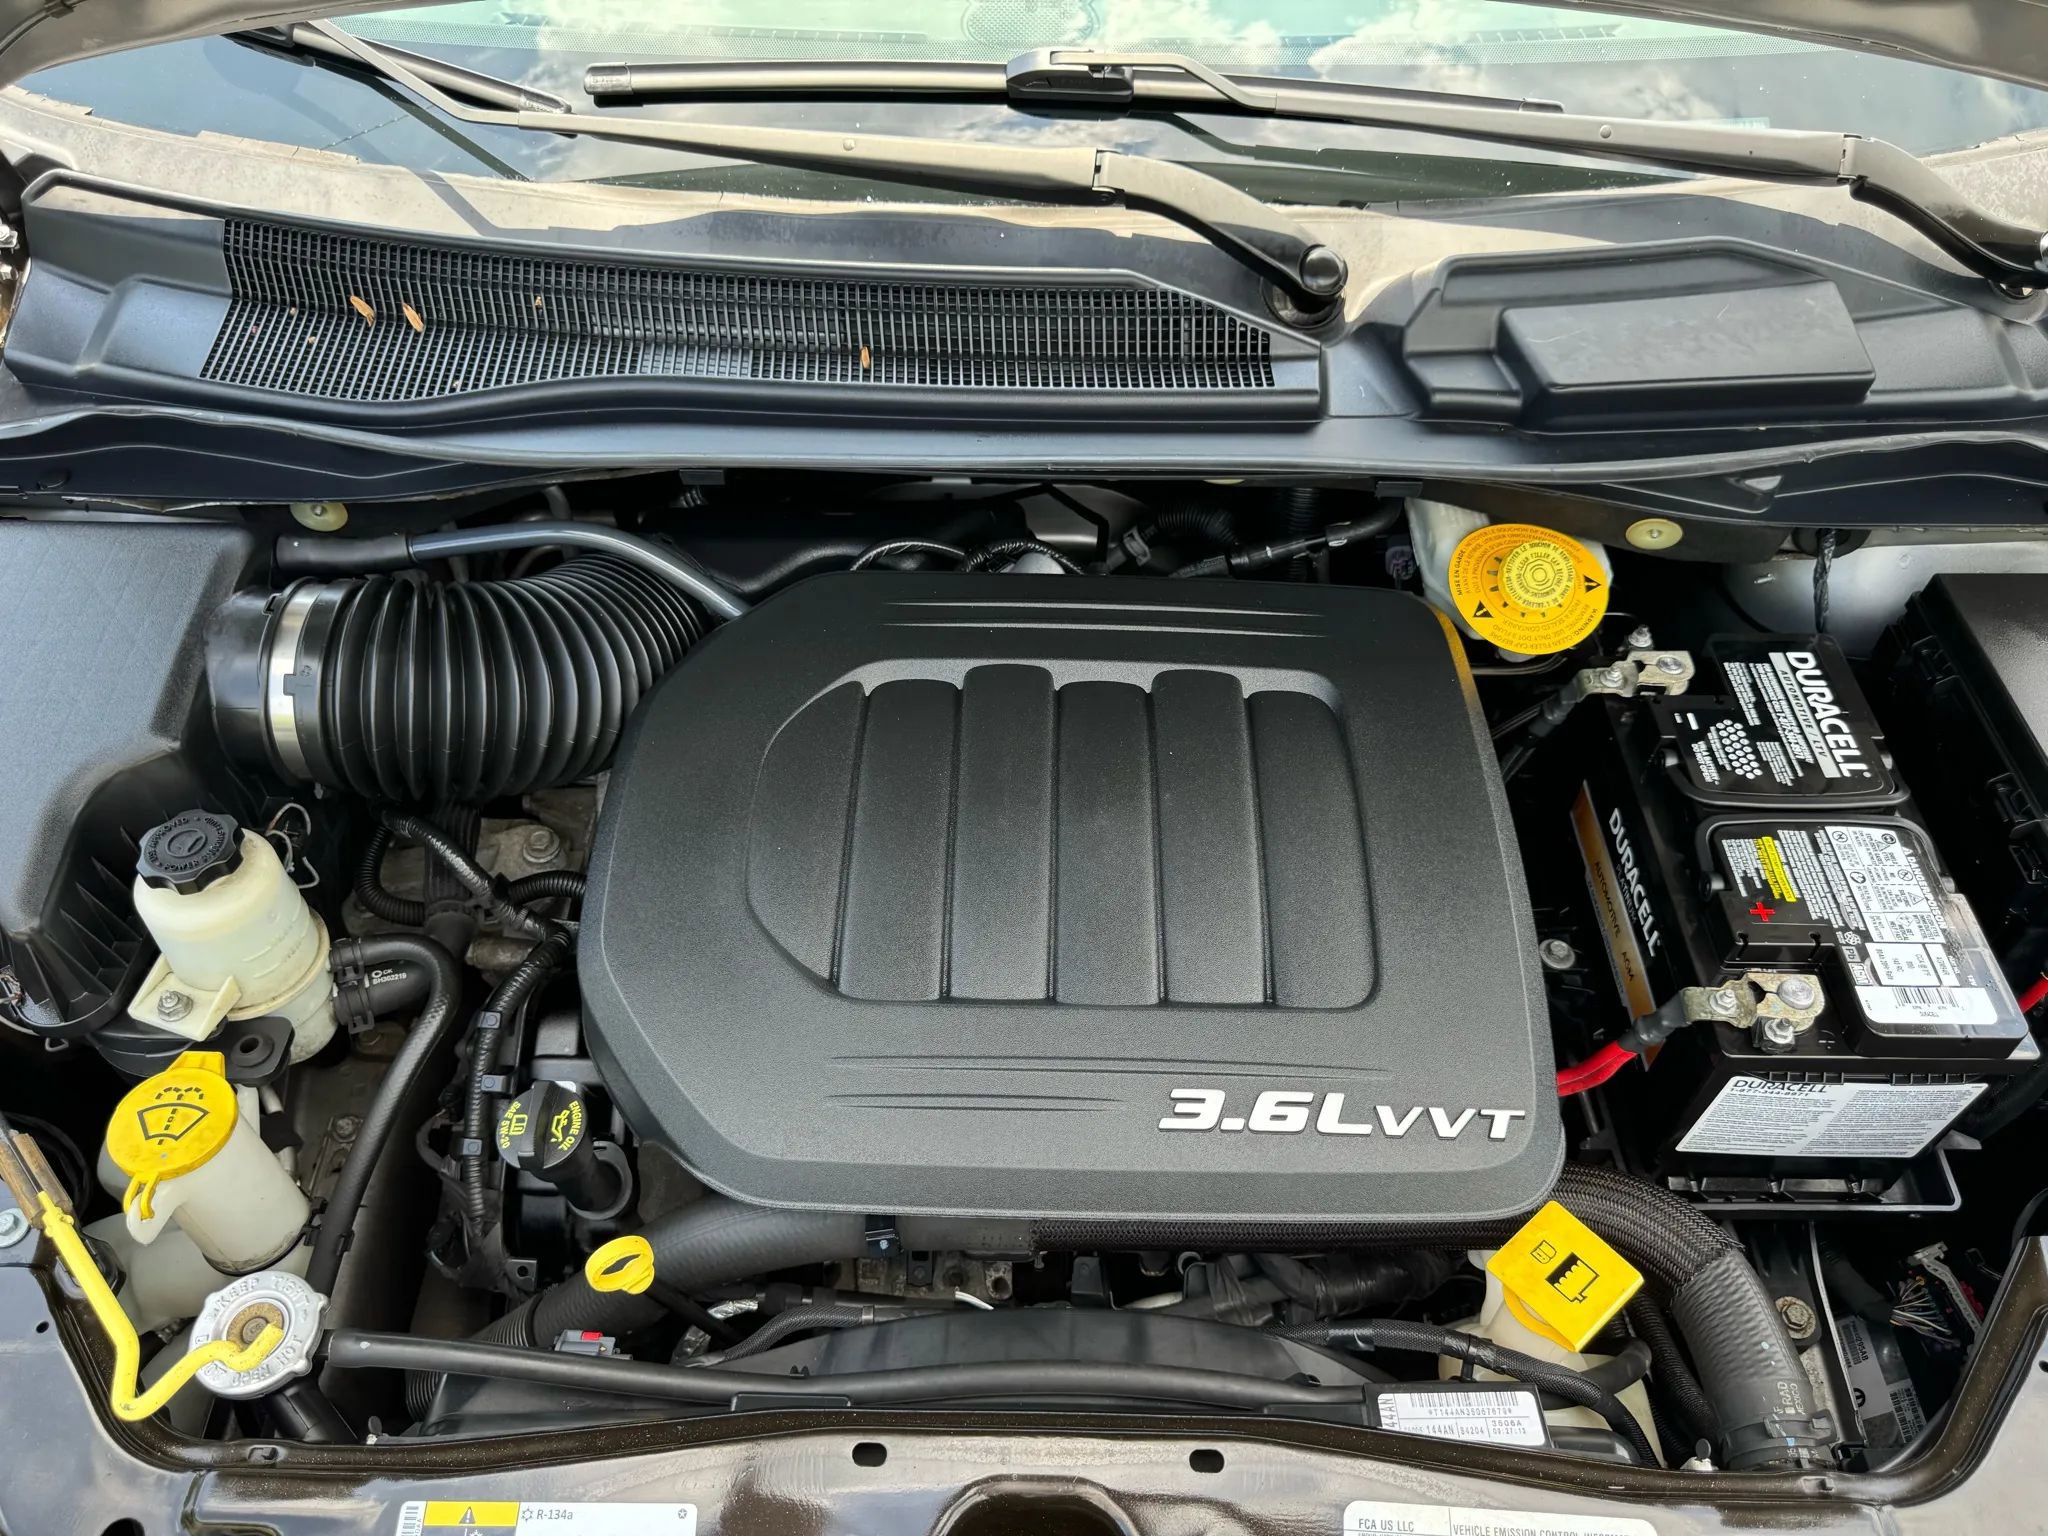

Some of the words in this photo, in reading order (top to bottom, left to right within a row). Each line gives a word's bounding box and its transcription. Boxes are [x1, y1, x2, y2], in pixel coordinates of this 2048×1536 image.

[1779, 670, 1813, 728] AUTOMOTIVE
[1785, 651, 1868, 778] DURACELL
[1609, 807, 1661, 957] DURACELL
[1615, 864, 1637, 923] PLATINUM
[1593, 861, 1622, 937] AUTOMOTIVE
[1844, 947, 1857, 959] Pb
[1733, 1080, 1827, 1093] DURACELL
[504, 1101, 521, 1120] SAE
[569, 1100, 583, 1135] ENGINE
[1374, 1104, 1526, 1140] VVT
[500, 1120, 511, 1149] 5W-20
[558, 1134, 577, 1152] OIL
[1777, 1381, 1793, 1405] RAD
[536, 1509, 573, 1520] R-134a
[1358, 1518, 1377, 1530] FCA
[1380, 1520, 1393, 1531] US
[1397, 1521, 1414, 1532] LLC
[1453, 1524, 1490, 1536] VEHICLE
